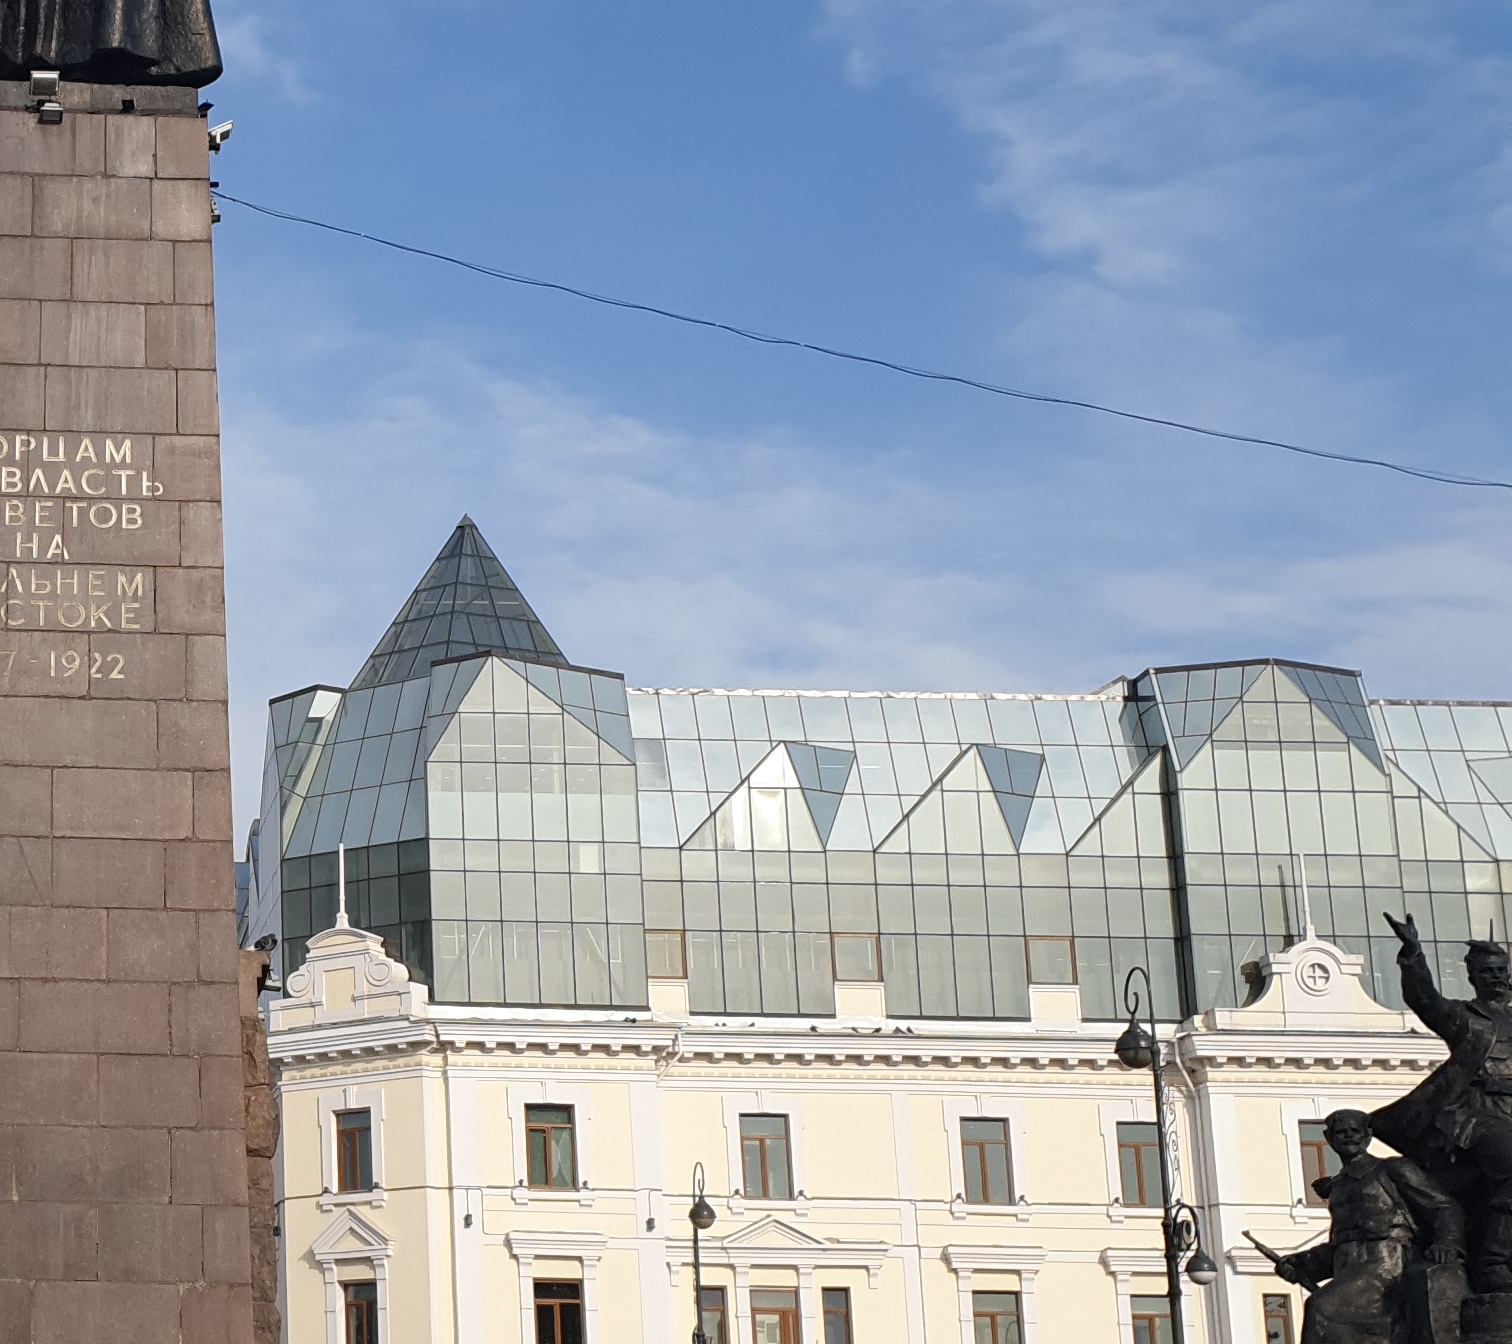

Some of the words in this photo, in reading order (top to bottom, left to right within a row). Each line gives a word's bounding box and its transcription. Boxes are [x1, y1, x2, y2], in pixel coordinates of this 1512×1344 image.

[1, 466, 164, 497] ВЛАСТЬ
[16, 532, 70, 560] НА
[50, 651, 126, 680] 1922
